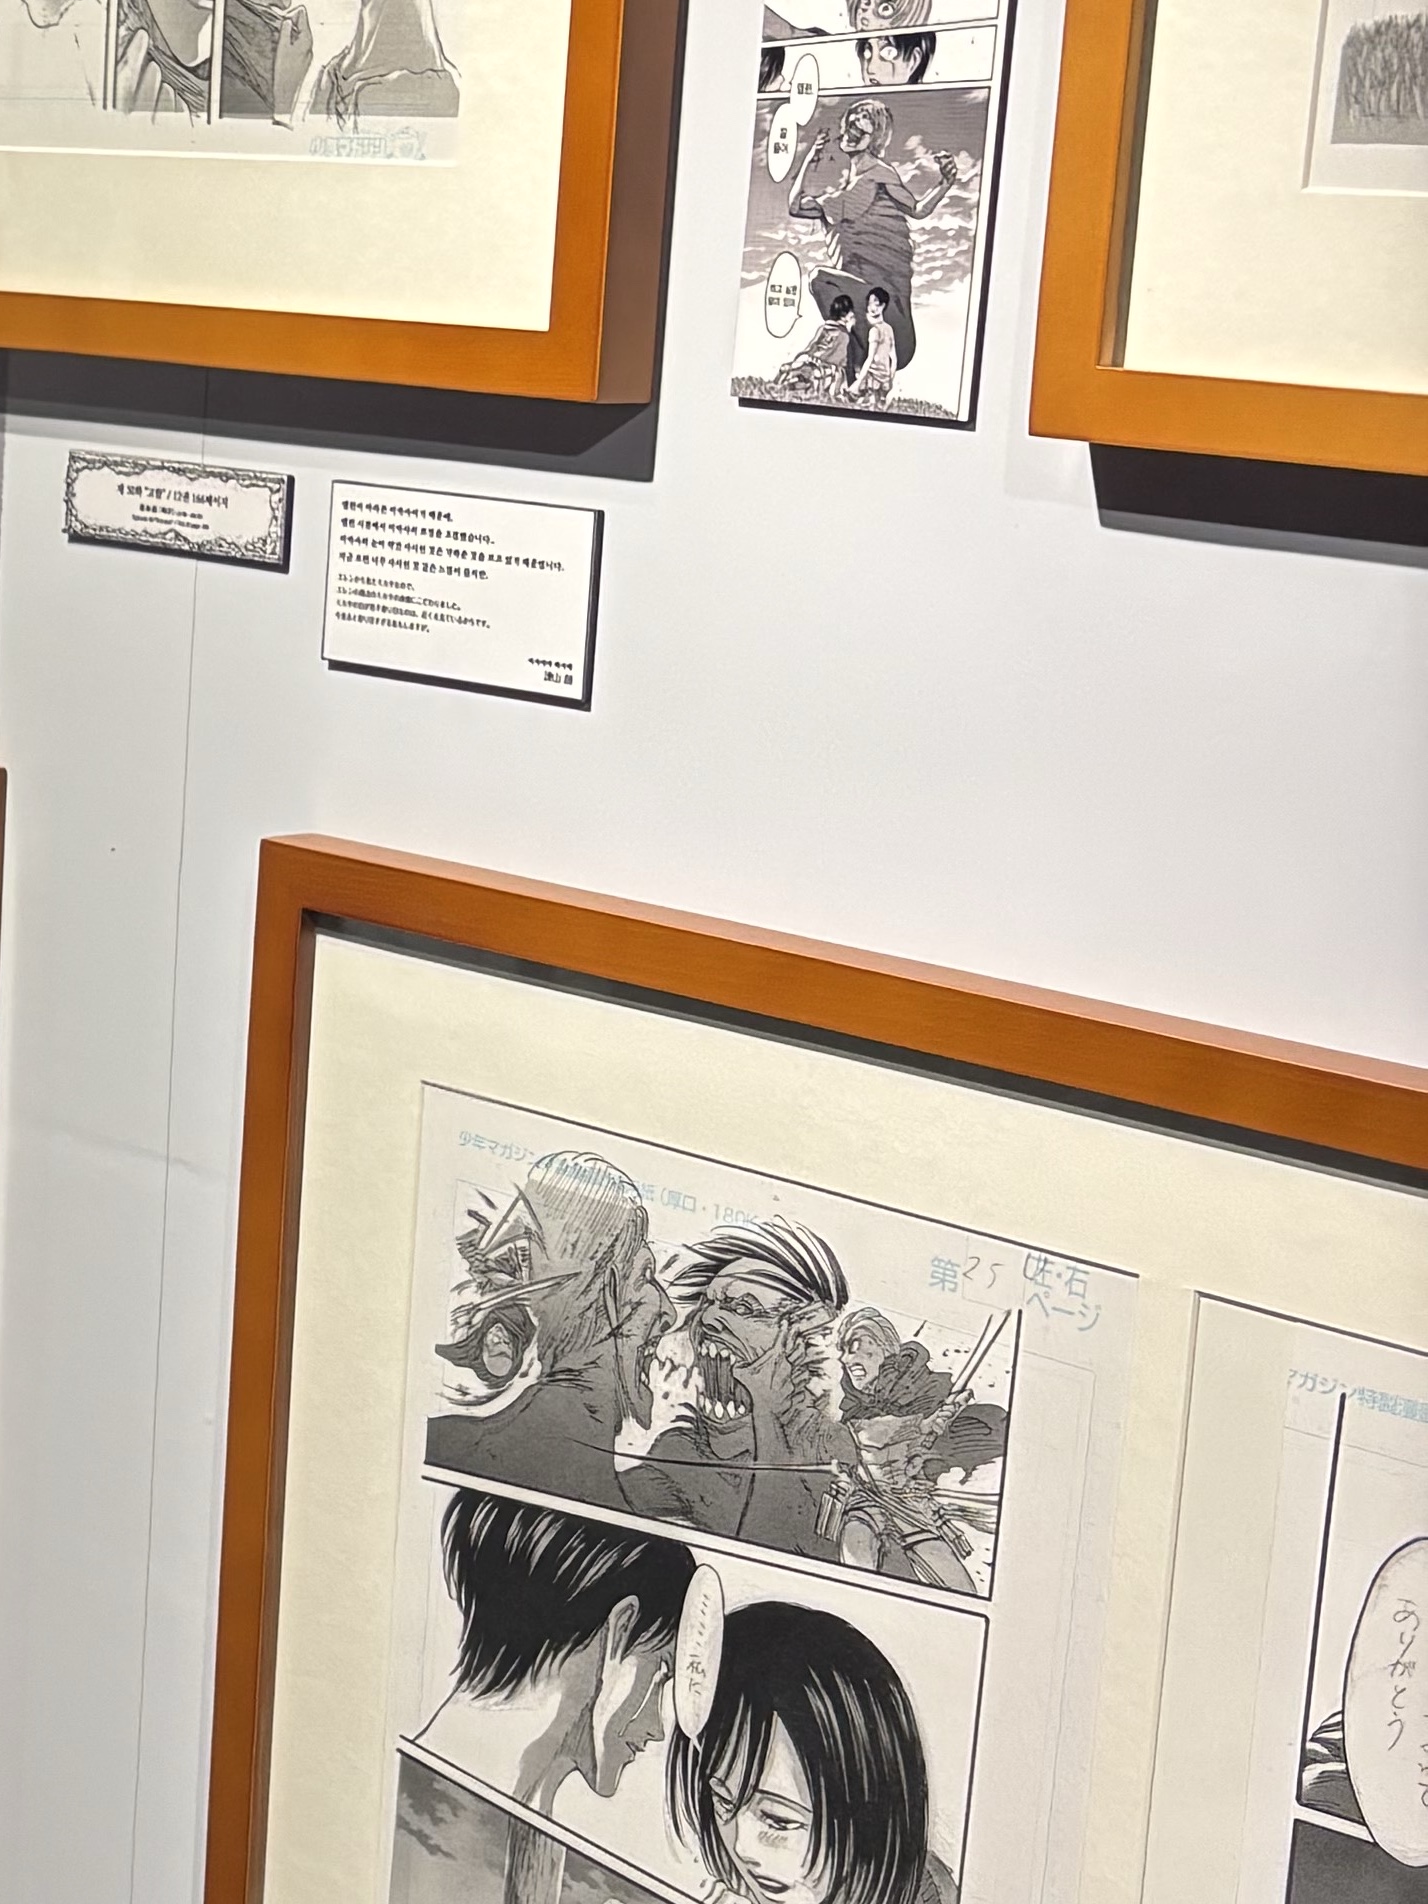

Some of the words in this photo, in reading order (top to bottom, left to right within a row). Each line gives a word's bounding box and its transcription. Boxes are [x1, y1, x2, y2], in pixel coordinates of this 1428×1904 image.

[928, 1255, 962, 1294] 第
[1026, 1291, 1103, 1332] ページ
[1387, 1597, 1419, 1752] ありがとう
